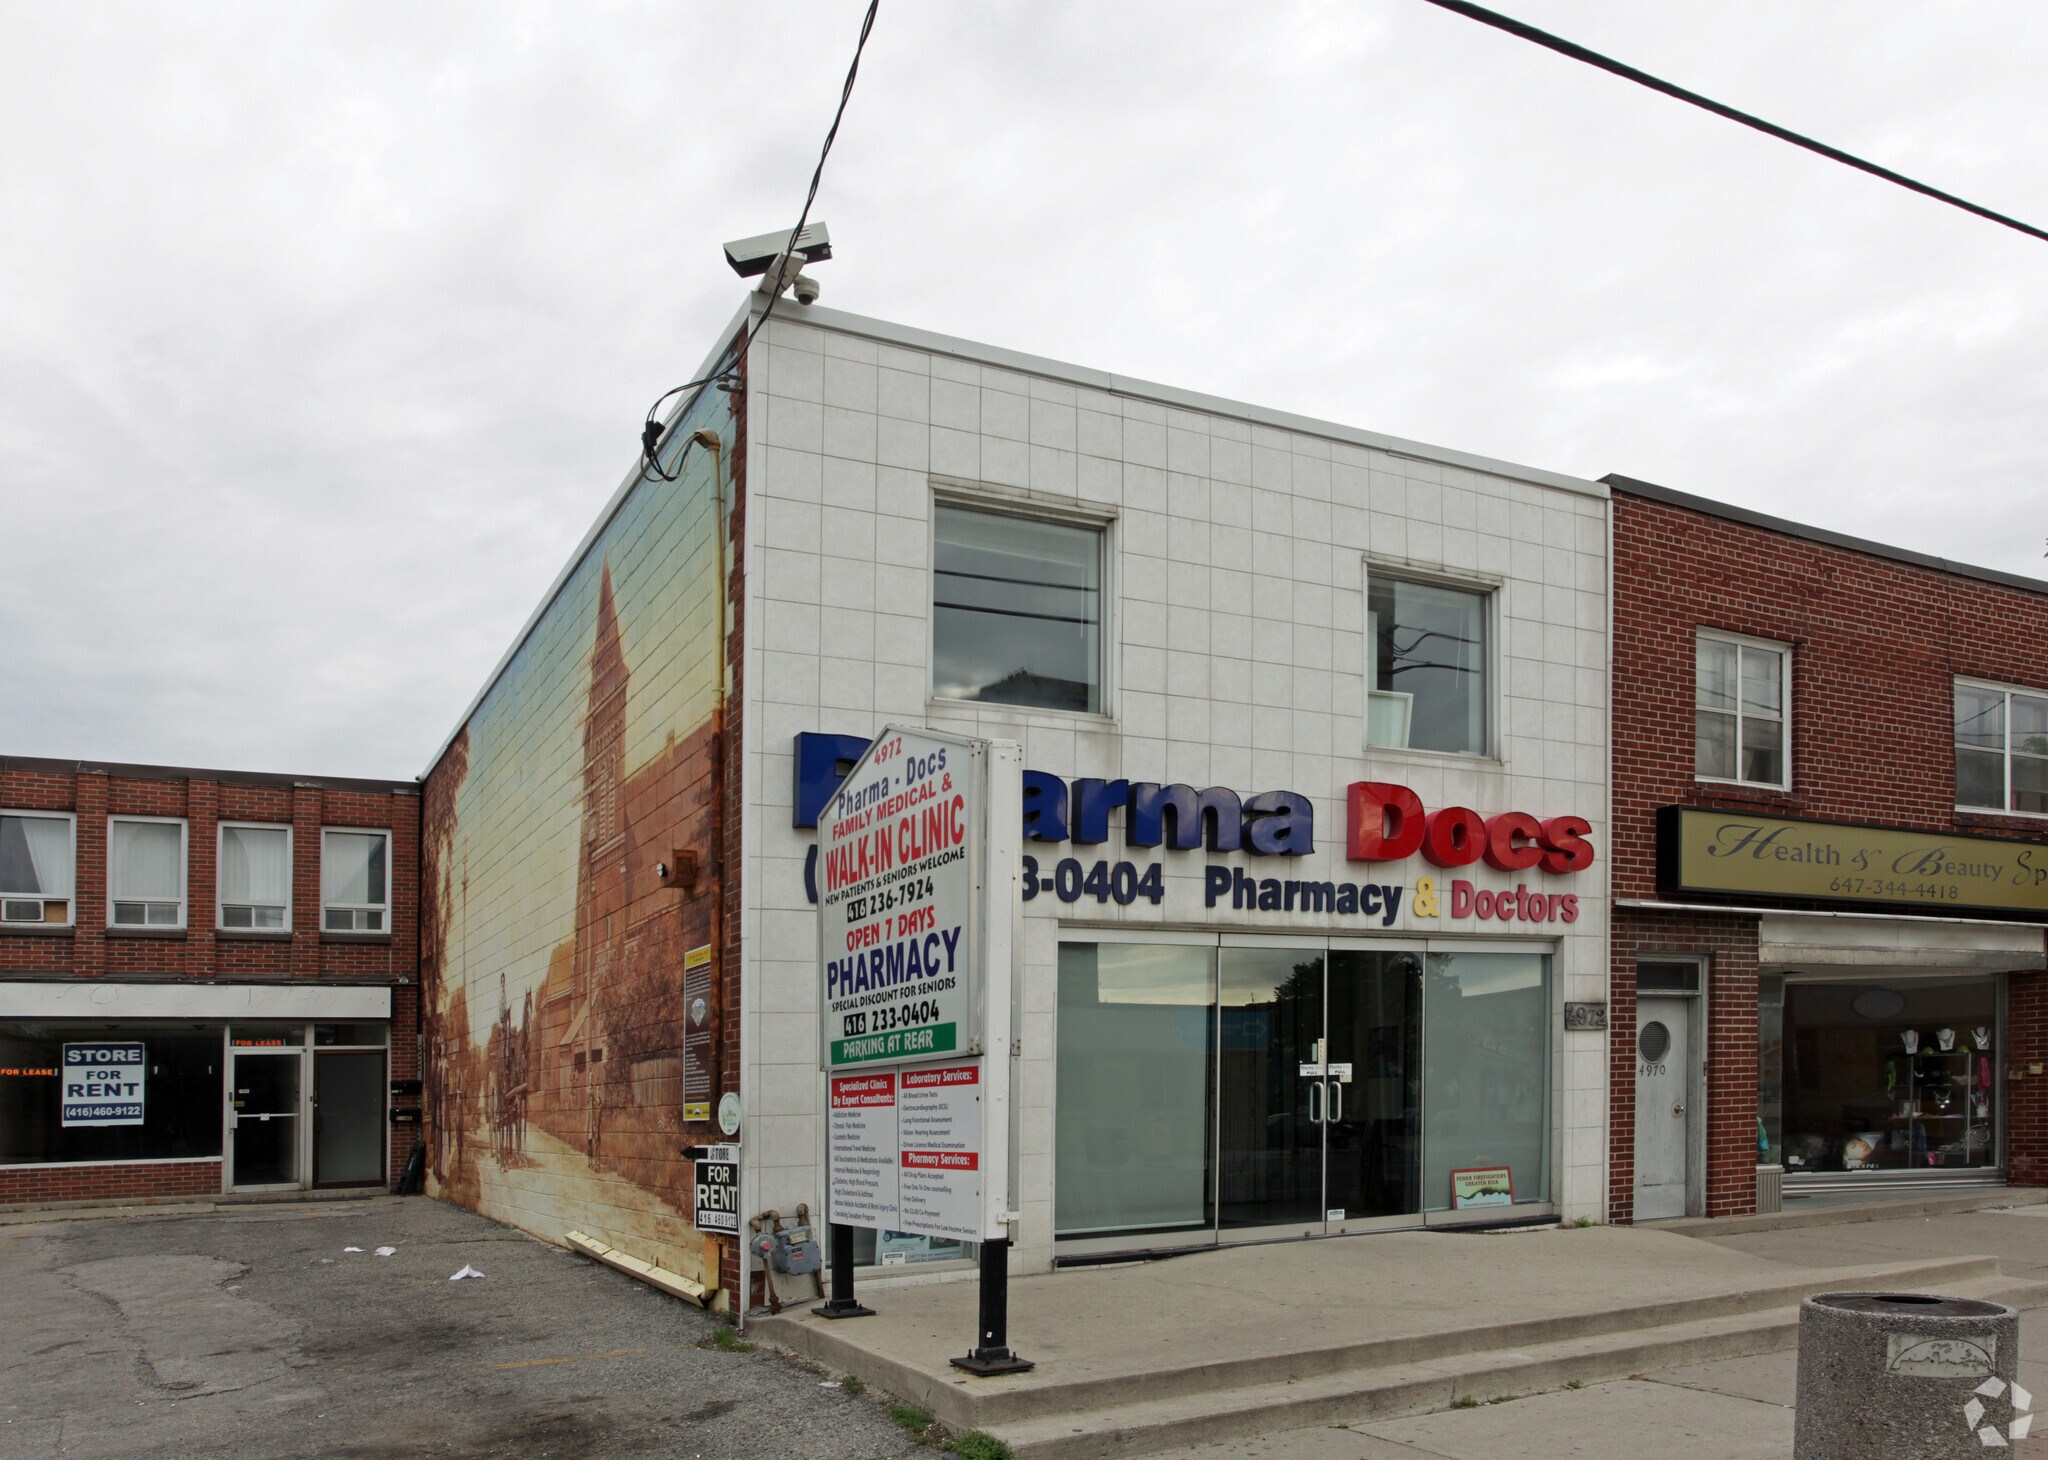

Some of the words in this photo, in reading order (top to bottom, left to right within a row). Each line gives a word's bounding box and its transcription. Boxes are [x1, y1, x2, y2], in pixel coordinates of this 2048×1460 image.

[874, 737, 902, 765] 4972
[838, 777, 889, 820] Pharma
[906, 748, 947, 786] Docs
[793, 731, 1314, 858] Parma
[1347, 781, 1595, 874] Docs
[832, 808, 873, 841] FAMILY
[877, 779, 936, 819] MEDICAL
[941, 772, 953, 793] &
[826, 826, 891, 893] WALK-IN
[899, 794, 965, 864] CLINIC
[1707, 824, 1841, 866] Health
[1852, 848, 1882, 871] &
[1892, 846, 2003, 881] Beauty
[2012, 850, 2047, 886] Sp
[825, 892, 840, 907] NEW
[841, 882, 875, 904] PATIENTS
[876, 877, 882, 888] &
[883, 863, 917, 886] SENIORS
[918, 846, 965, 873] WELCOME
[1022, 855, 1164, 905] 3-0404
[1206, 865, 1403, 926] Pharmacy
[1413, 876, 1439, 918] &
[1452, 880, 1579, 923] Doctors
[1830, 877, 1959, 900] 647-344-4418
[848, 900, 866, 921] 416
[870, 876, 934, 915] 236-7924
[846, 922, 880, 952] OPEN
[885, 918, 892, 944] 7
[899, 905, 935, 937] DAYS
[827, 925, 962, 1001] PHARMACY
[832, 996, 858, 1013] SPECIAL
[859, 989, 898, 1008] DISCOUNT
[900, 985, 916, 1000] FOR
[918, 976, 956, 995] SENIORS
[845, 1015, 866, 1034] 416
[872, 998, 940, 1032] 233-0404
[67, 1050, 140, 1062] STORE
[843, 1036, 885, 1059] PARKING
[887, 1033, 901, 1051] AT
[903, 1029, 933, 1050] REAR
[86, 1071, 121, 1080] FOR
[907, 1073, 941, 1084] Laboratory
[943, 1070, 972, 1081] Services:
[1639, 1065, 1667, 1077] 4970
[67, 1083, 139, 1097] RENT
[833, 1096, 840, 1107] By
[842, 1095, 859, 1106] Expert
[861, 1093, 894, 1104] Consultants:
[840, 1080, 868, 1093] Specialized
[870, 1079, 888, 1090] Clinics
[710, 1148, 729, 1160] STORE
[908, 1153, 940, 1166] Pharmacy
[940, 1154, 970, 1166] Services:
[708, 1166, 729, 1183] FOR
[697, 1184, 737, 1211] RENT
[700, 1213, 711, 1223] 416
